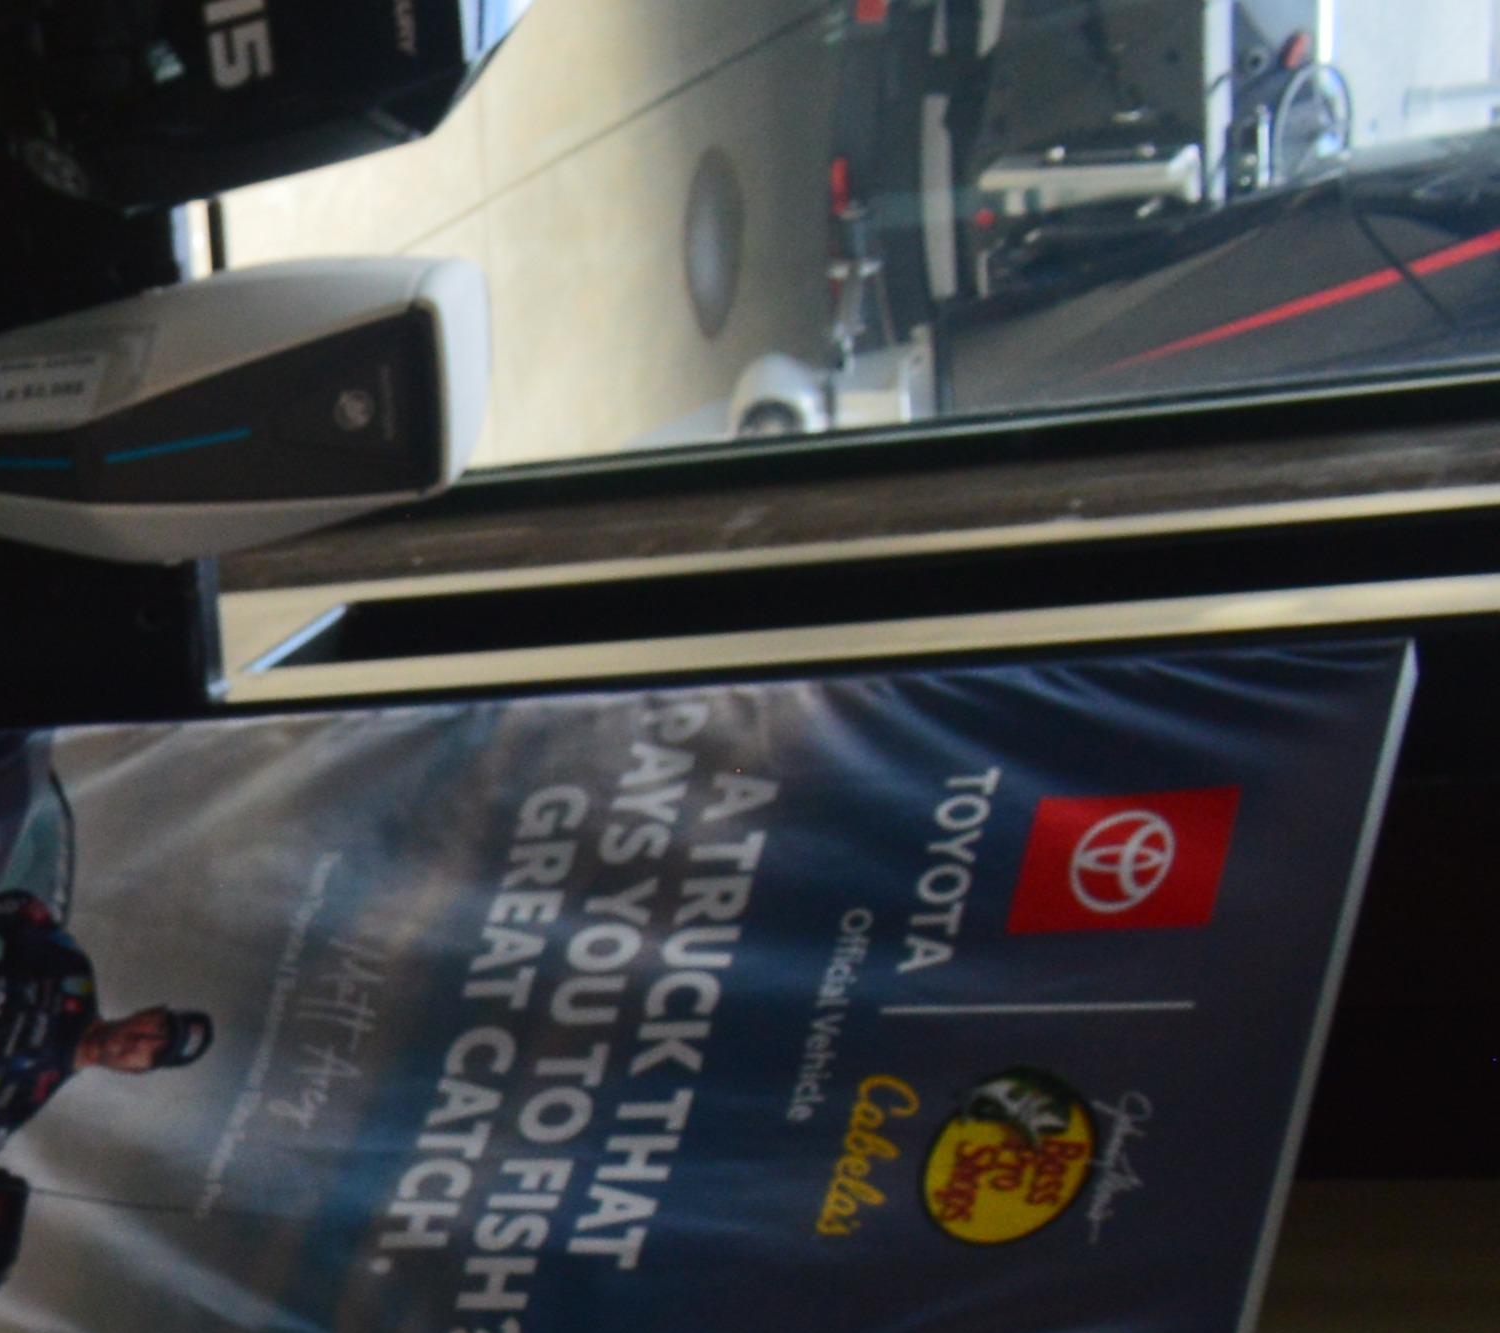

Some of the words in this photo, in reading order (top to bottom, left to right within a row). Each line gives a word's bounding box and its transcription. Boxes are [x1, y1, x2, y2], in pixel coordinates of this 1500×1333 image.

[599, 701, 710, 866] PAYS
[702, 770, 780, 822] A
[463, 784, 591, 1010] GREAT
[896, 765, 1003, 974] TOYOTA
[549, 876, 659, 1027] YOU
[629, 830, 767, 1077] TRUCK
[815, 906, 874, 1008] Official
[518, 1042, 611, 1144] TO
[786, 1012, 845, 1123] Vehicle
[370, 1025, 517, 1276] CATCH.
[566, 1087, 694, 1270] THAT
[815, 1072, 921, 1237] Cabela's
[933, 1140, 1000, 1222] Shops
[988, 1131, 1038, 1192] Pro
[1024, 1138, 1090, 1206] Bass
